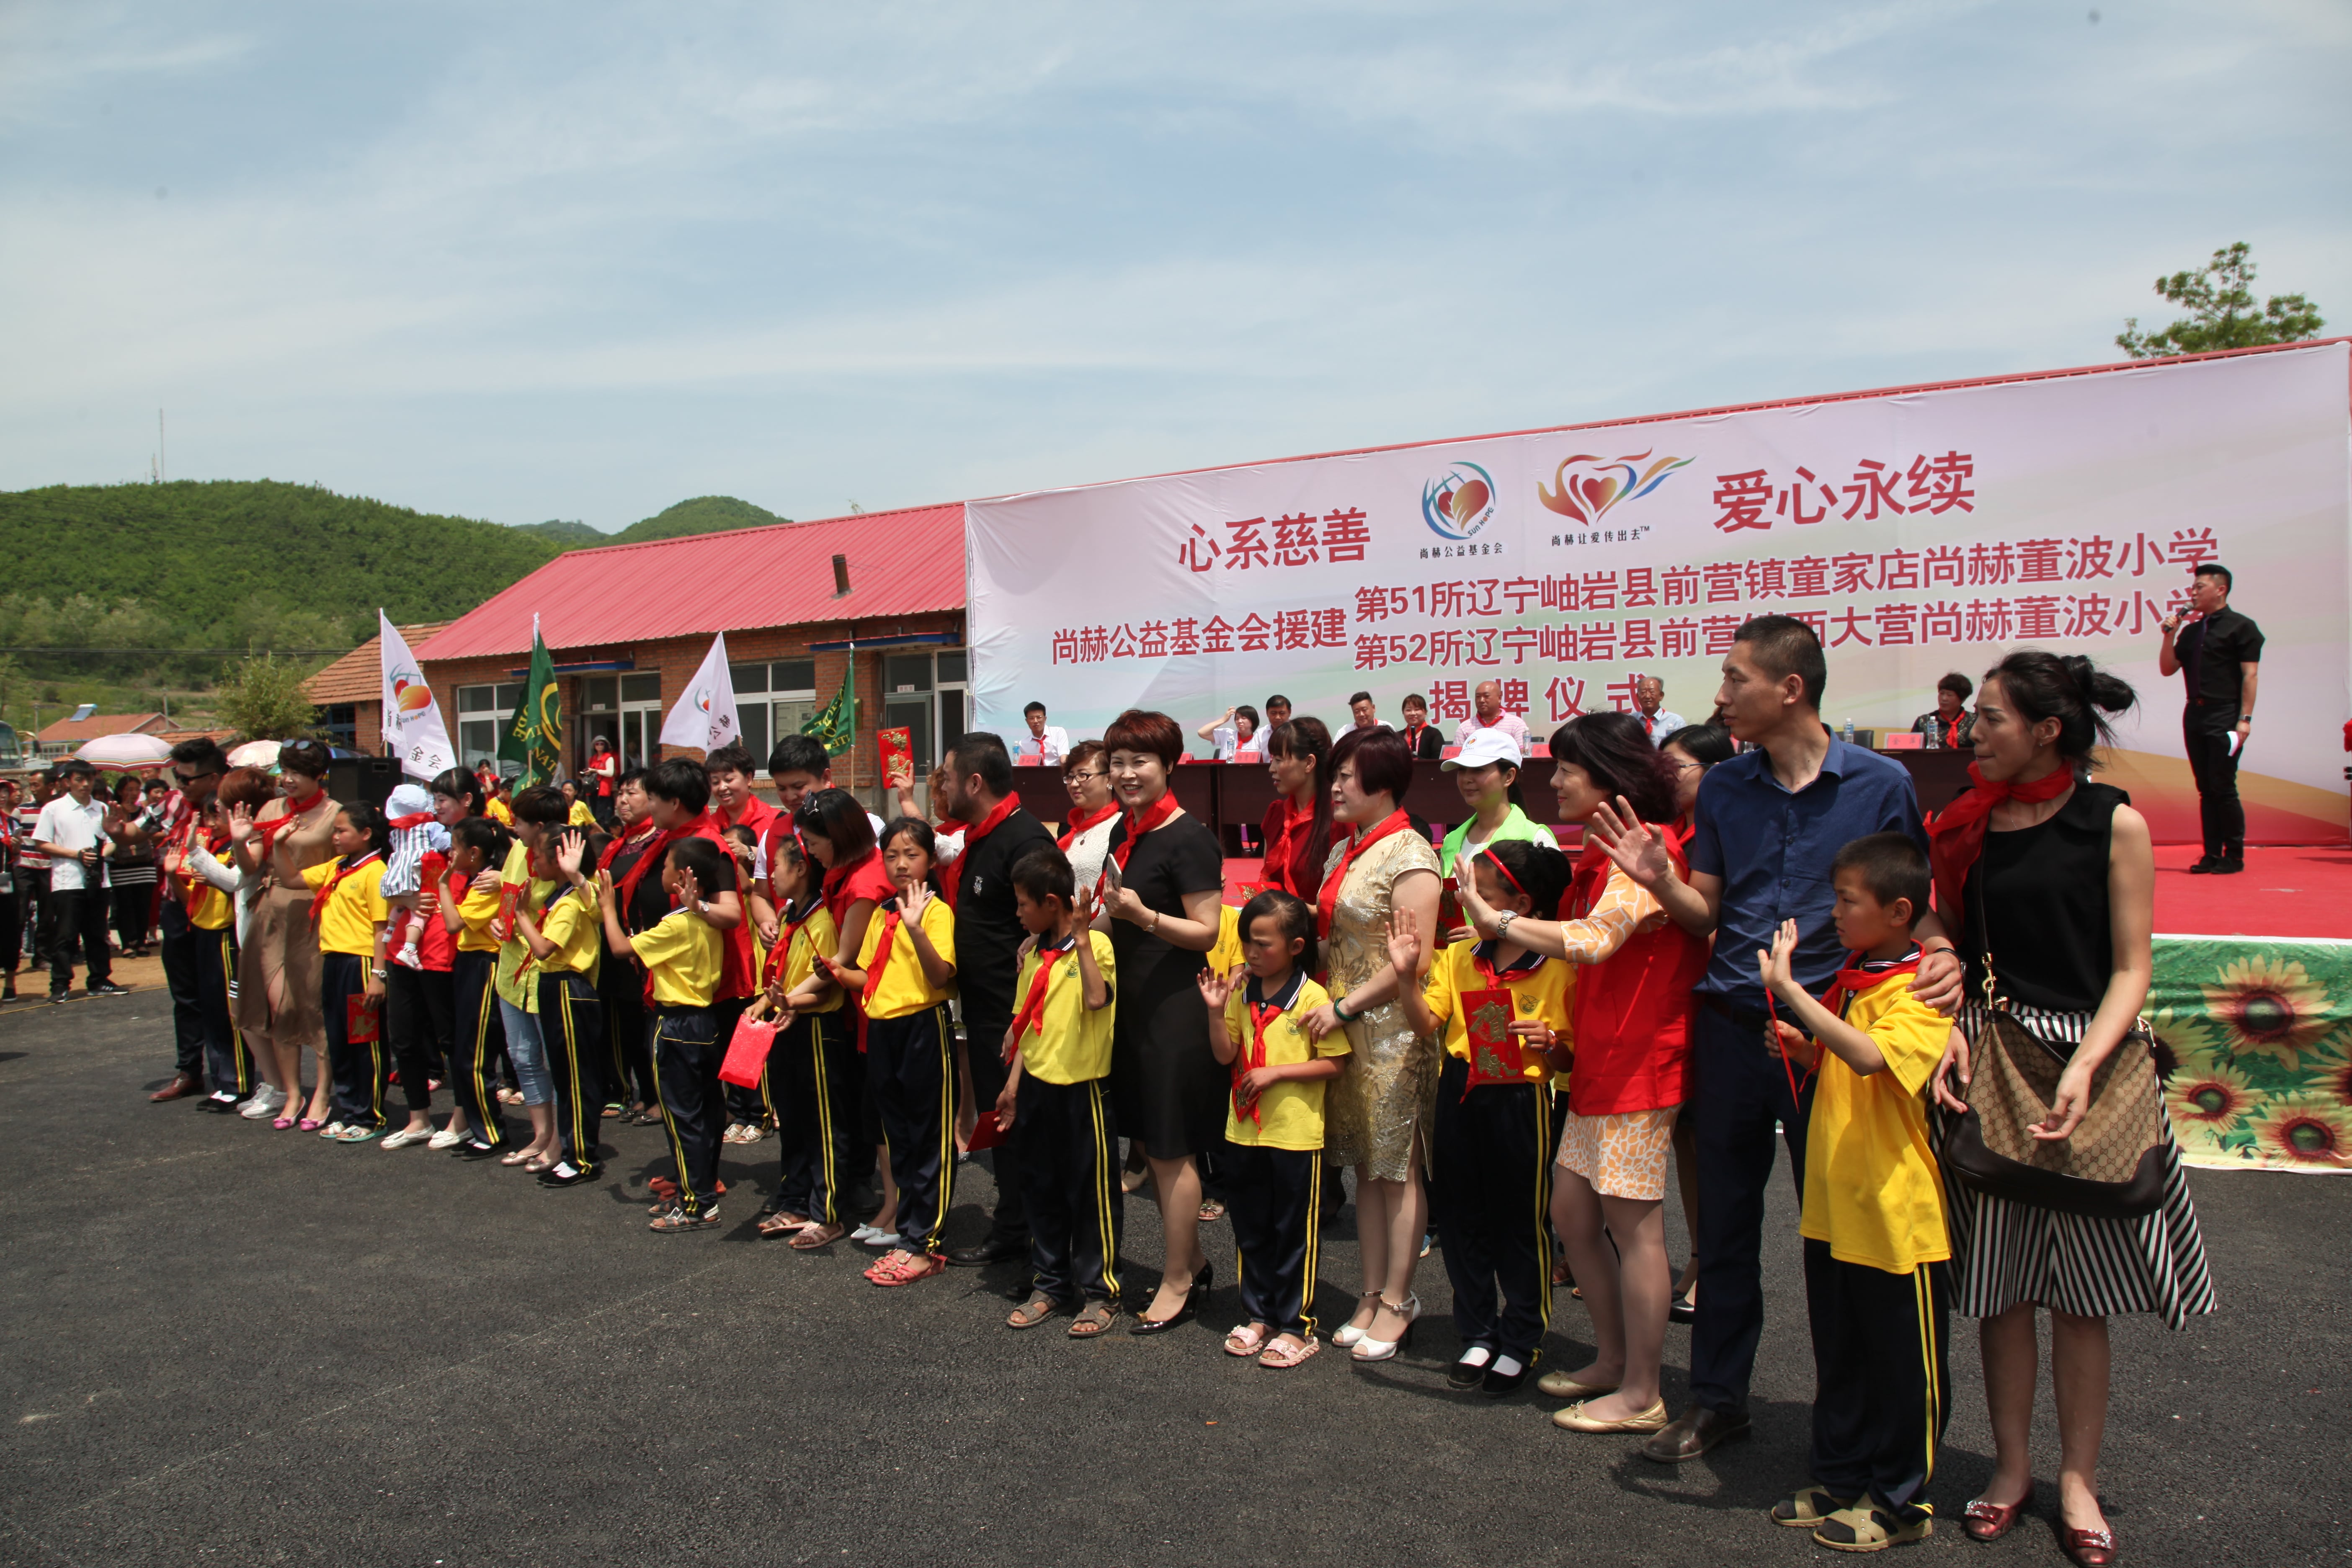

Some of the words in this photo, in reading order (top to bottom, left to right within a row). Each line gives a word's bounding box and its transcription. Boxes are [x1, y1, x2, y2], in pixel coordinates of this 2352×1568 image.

[1713, 451, 1975, 534] 爱心永续
[1179, 507, 1371, 573] 心系慈善
[1420, 542, 1503, 559] 尚赫公益基金会
[1552, 529, 1640, 546] 尚赫让爱传出去
[1354, 528, 2218, 622] 第51所辽宁岫岩县前营镇童家店尚赫董波小学
[1052, 607, 1347, 665] 尚赫公益基金会援建
[1353, 587, 2204, 671] 第52所辽宁岫岩县前营西大营尚赫董波小学
